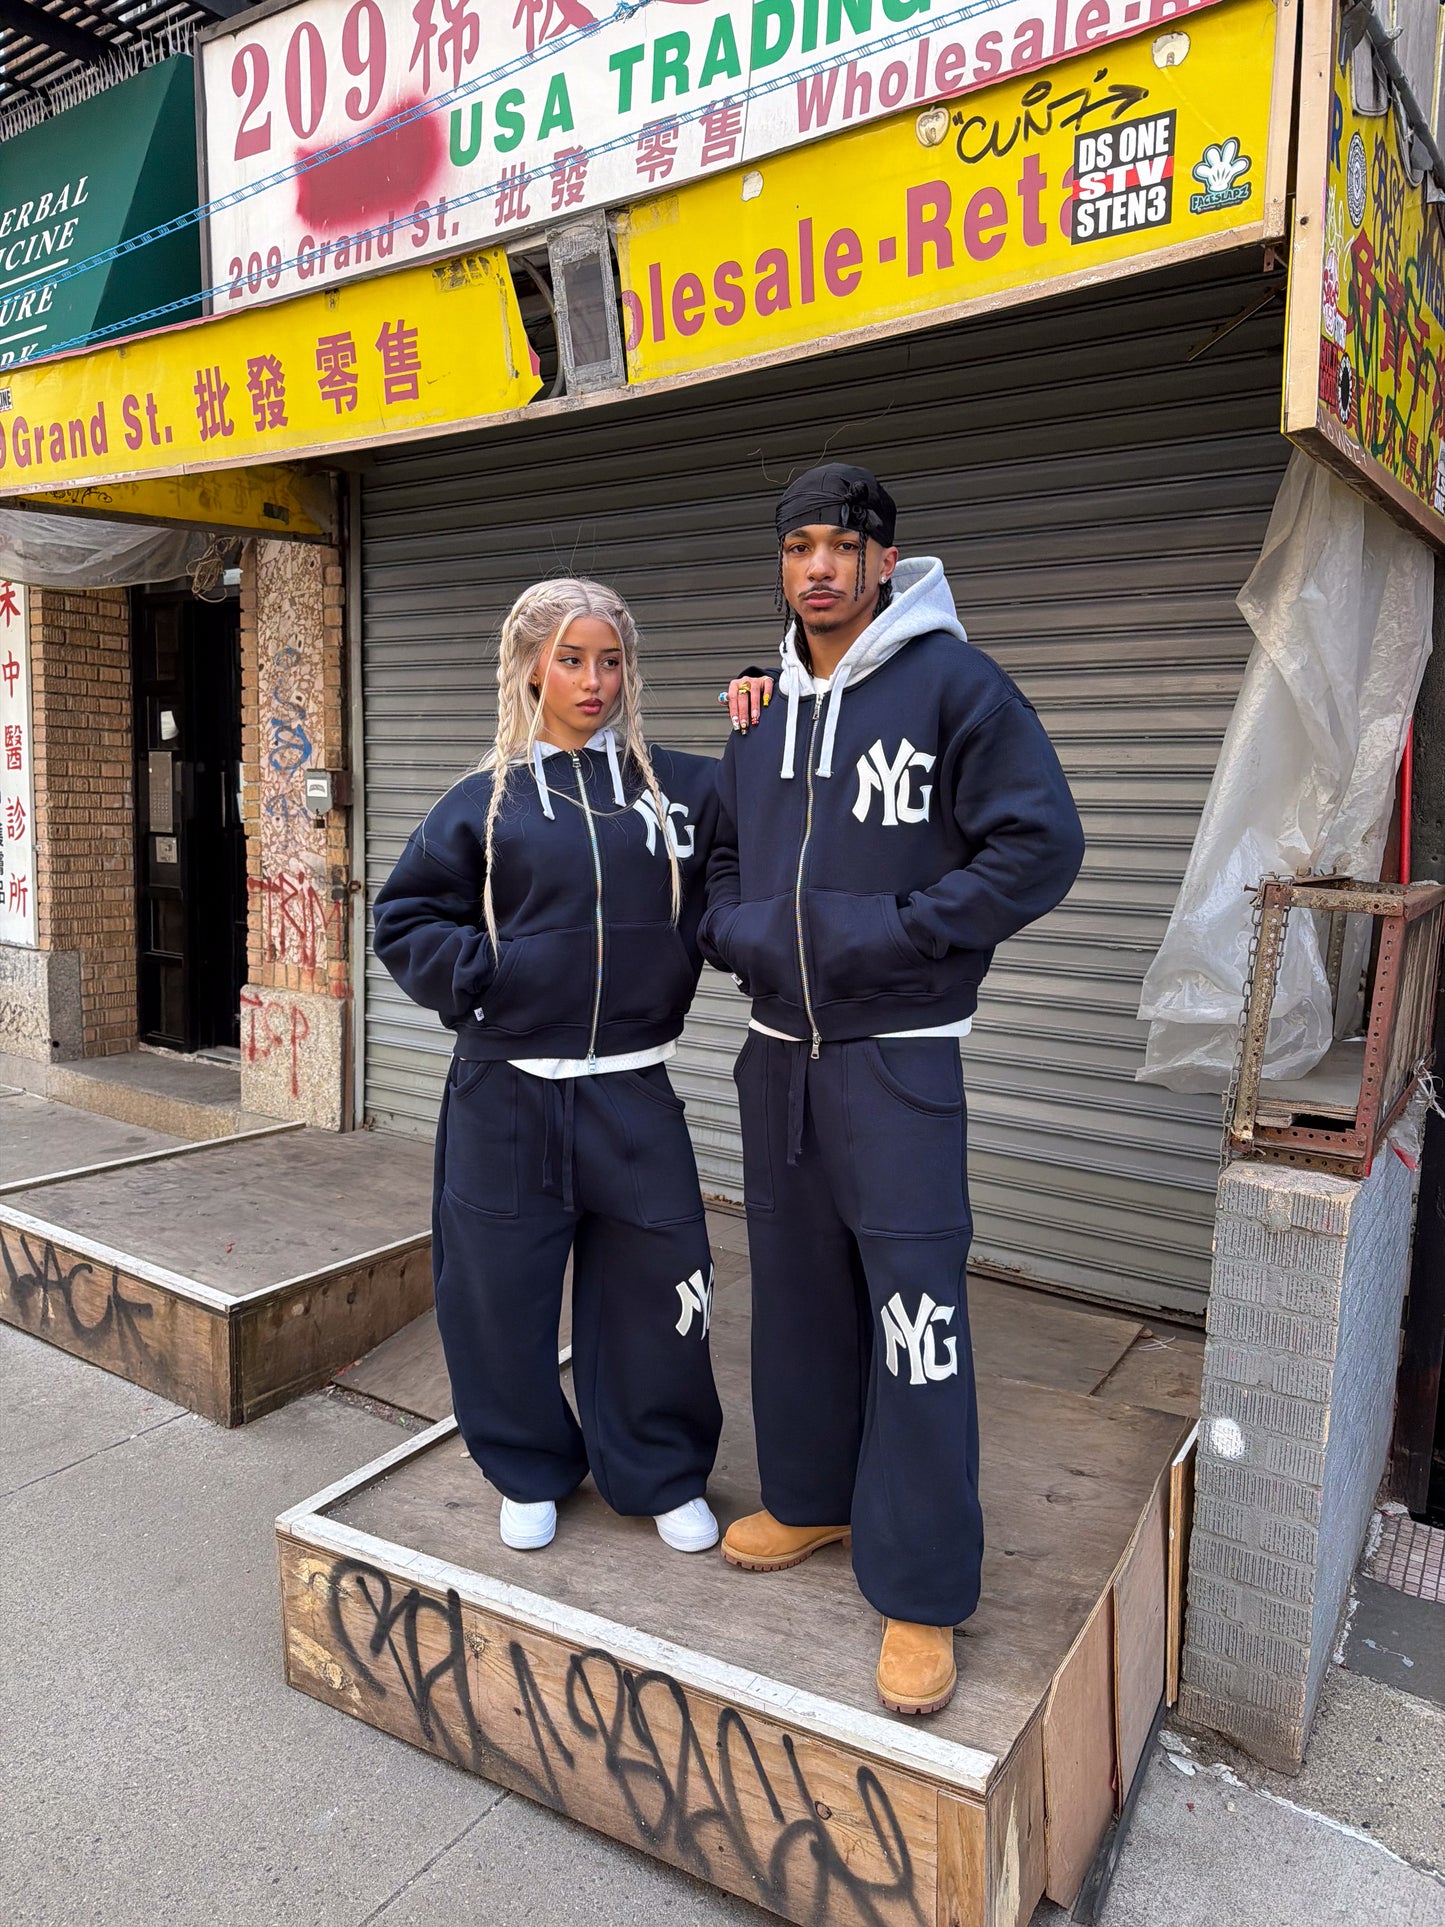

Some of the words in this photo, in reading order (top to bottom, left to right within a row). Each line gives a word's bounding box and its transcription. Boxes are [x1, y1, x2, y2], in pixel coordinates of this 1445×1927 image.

[231, 0, 387, 161] 209
[449, 72, 575, 168] USA
[1078, 132, 1113, 174] DS
[1118, 117, 1170, 163] ONE
[1076, 185, 1167, 238] STEN3
[1078, 155, 1168, 200] STV
[1192, 184, 1249, 211] FACESLAPZ
[228, 246, 282, 300] 209
[296, 210, 395, 280] Grand
[411, 196, 460, 249] St.
[122, 391, 173, 450] St.
[193, 319, 422, 442] 批發零售
